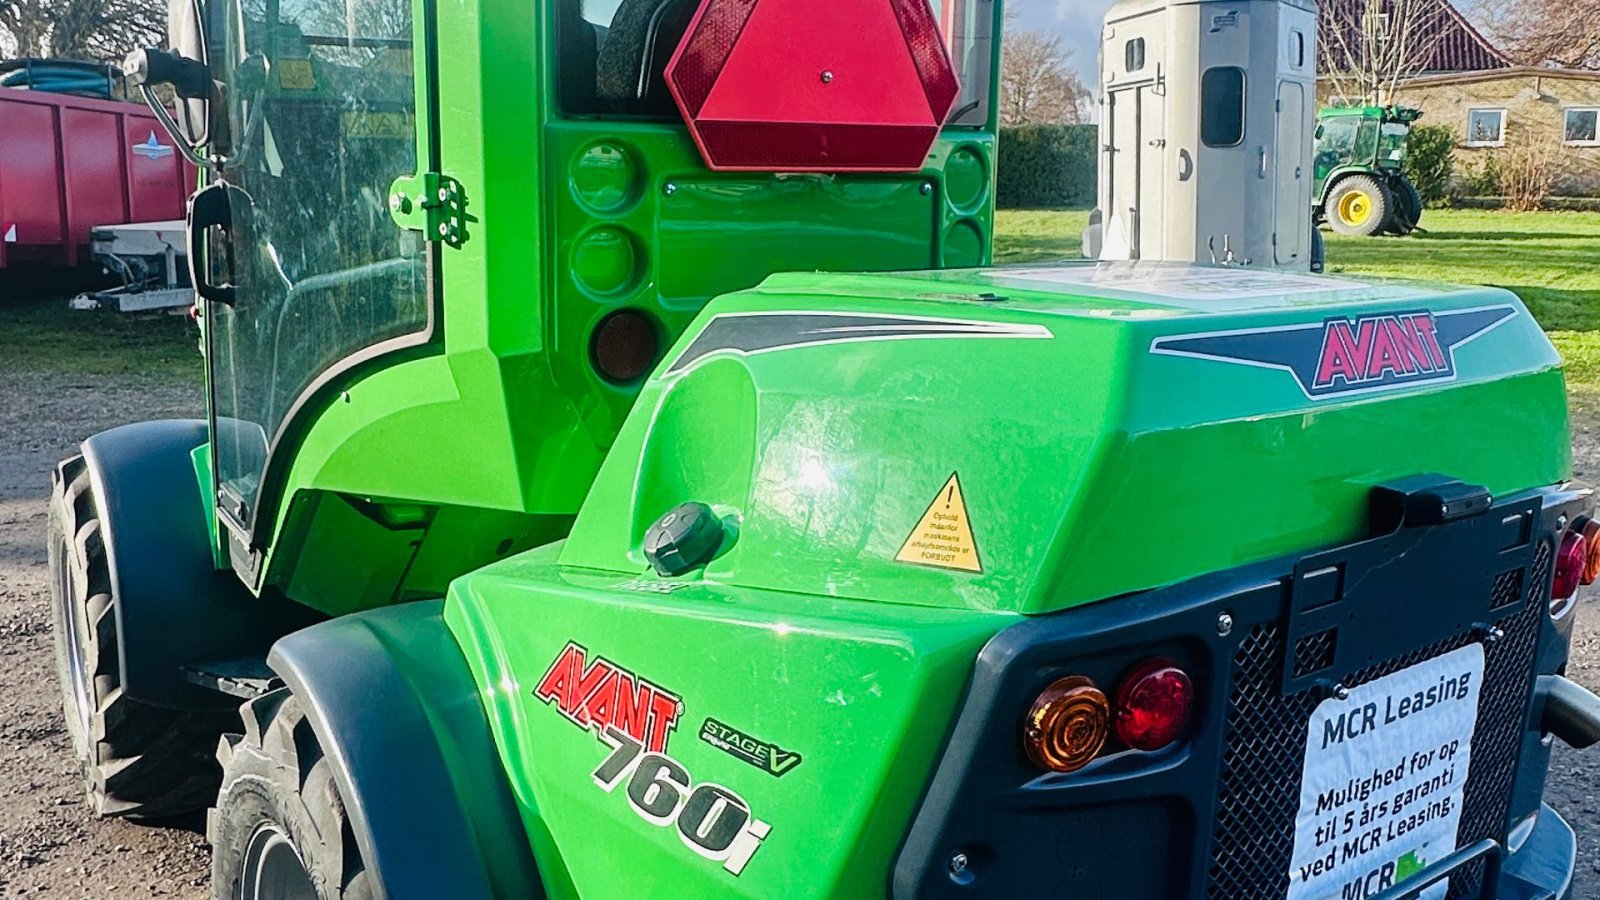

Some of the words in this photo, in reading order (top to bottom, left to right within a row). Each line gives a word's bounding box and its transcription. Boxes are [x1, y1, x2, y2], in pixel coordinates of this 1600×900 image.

[1312, 312, 1449, 389] AVANT
[532, 639, 685, 755] AVANT
[1321, 702, 1377, 750] MCR
[1384, 671, 1472, 725] Leasing
[704, 720, 770, 759] STAGE
[770, 746, 798, 773] V
[1314, 755, 1406, 816] Mulighed
[1409, 751, 1436, 775] for
[1438, 738, 1459, 761] op
[590, 725, 773, 877] 760i
[1299, 845, 1337, 882] ved
[1341, 826, 1382, 865] MCR
[1386, 795, 1455, 842] Leasing.
[1314, 815, 1337, 847] til
[1342, 809, 1355, 835] 5
[1359, 799, 1388, 827] års
[1391, 762, 1455, 815] garanti
[1341, 861, 1395, 900] MCR
